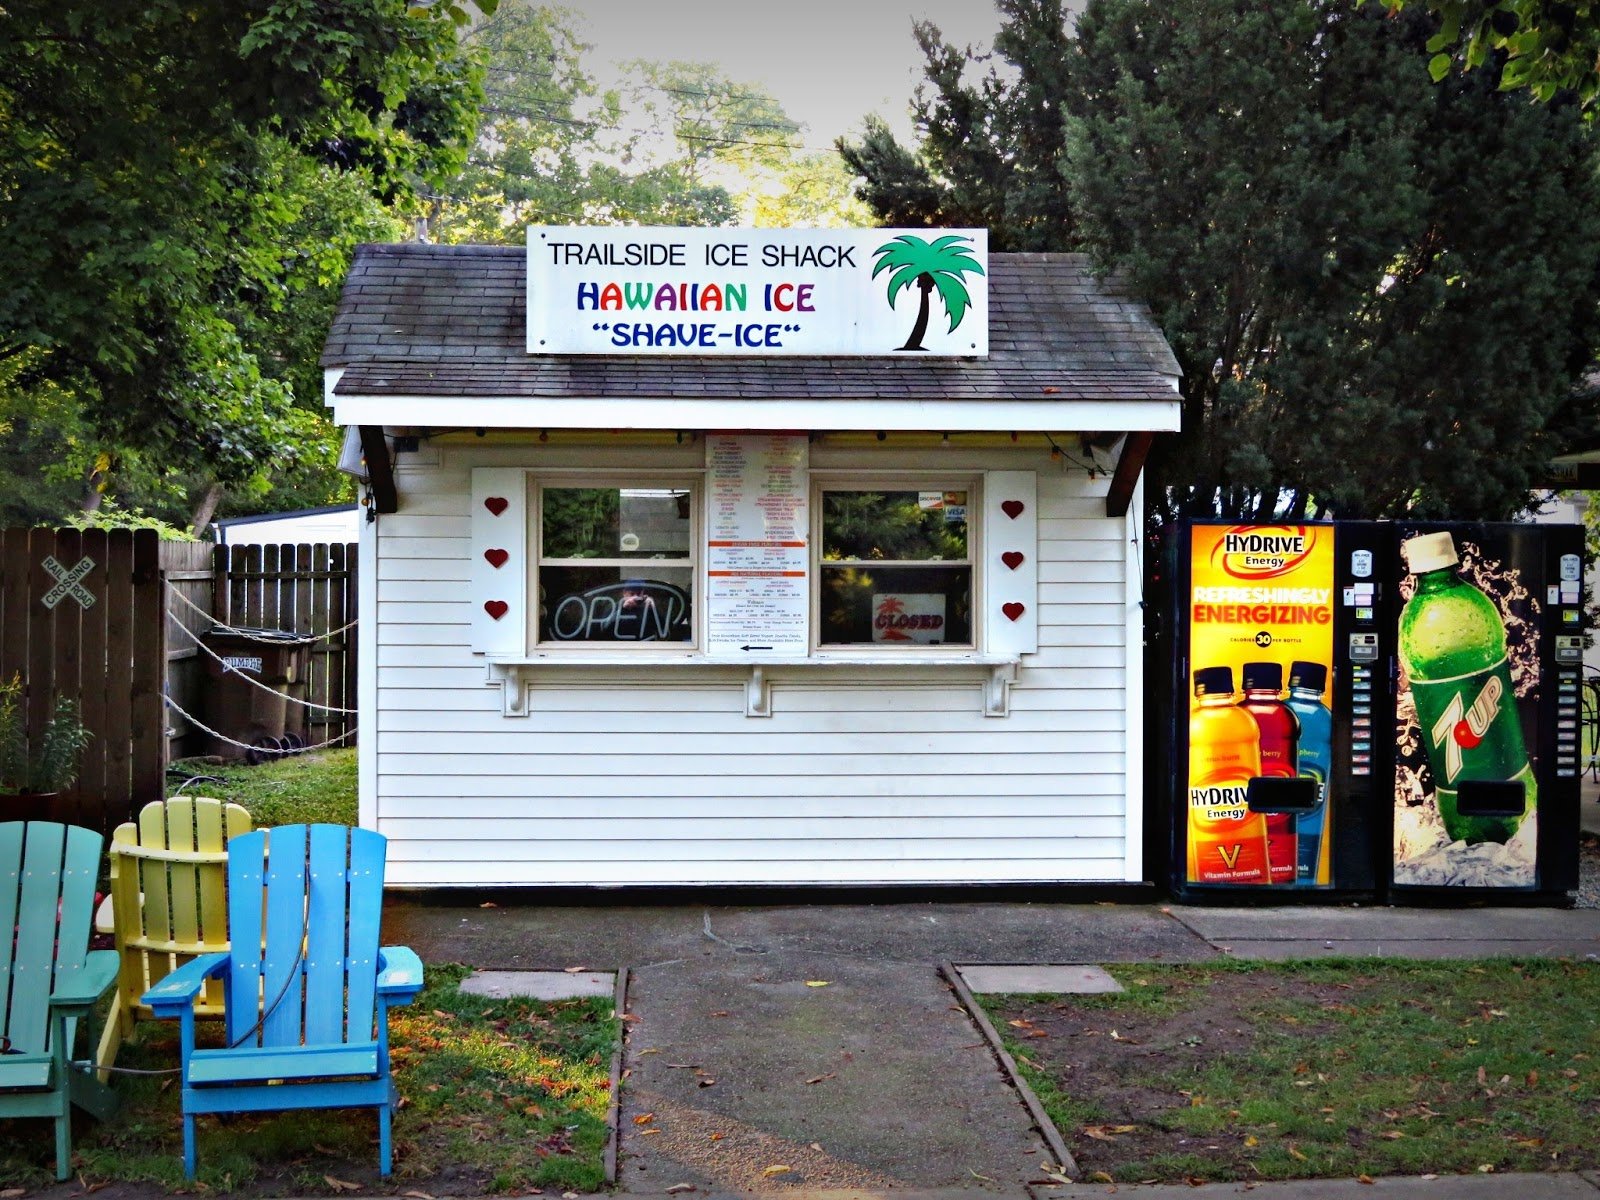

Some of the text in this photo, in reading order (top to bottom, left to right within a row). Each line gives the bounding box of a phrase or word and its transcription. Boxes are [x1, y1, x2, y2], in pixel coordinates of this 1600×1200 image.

[547, 243, 857, 268] TRAILSIDE ICE SHACK
[577, 282, 816, 312] HAWAIIAN ICE
[1245, 556, 1285, 567] Energy
[43, 558, 93, 607] RAIL ROAD
[45, 560, 91, 604] CROSSING
[1193, 587, 1331, 605] REFRESHINGLY
[554, 596, 674, 639] OPEN
[874, 613, 944, 630] CLOSED
[1193, 605, 1331, 624] ENERGIZING
[1256, 634, 1271, 645] 30
[1262, 749, 1281, 759] berry
[1191, 787, 1249, 806] HYDRIV
[1207, 809, 1245, 819] Energy
[1217, 845, 1241, 869] V
[1232, 869, 1261, 877] Formula
